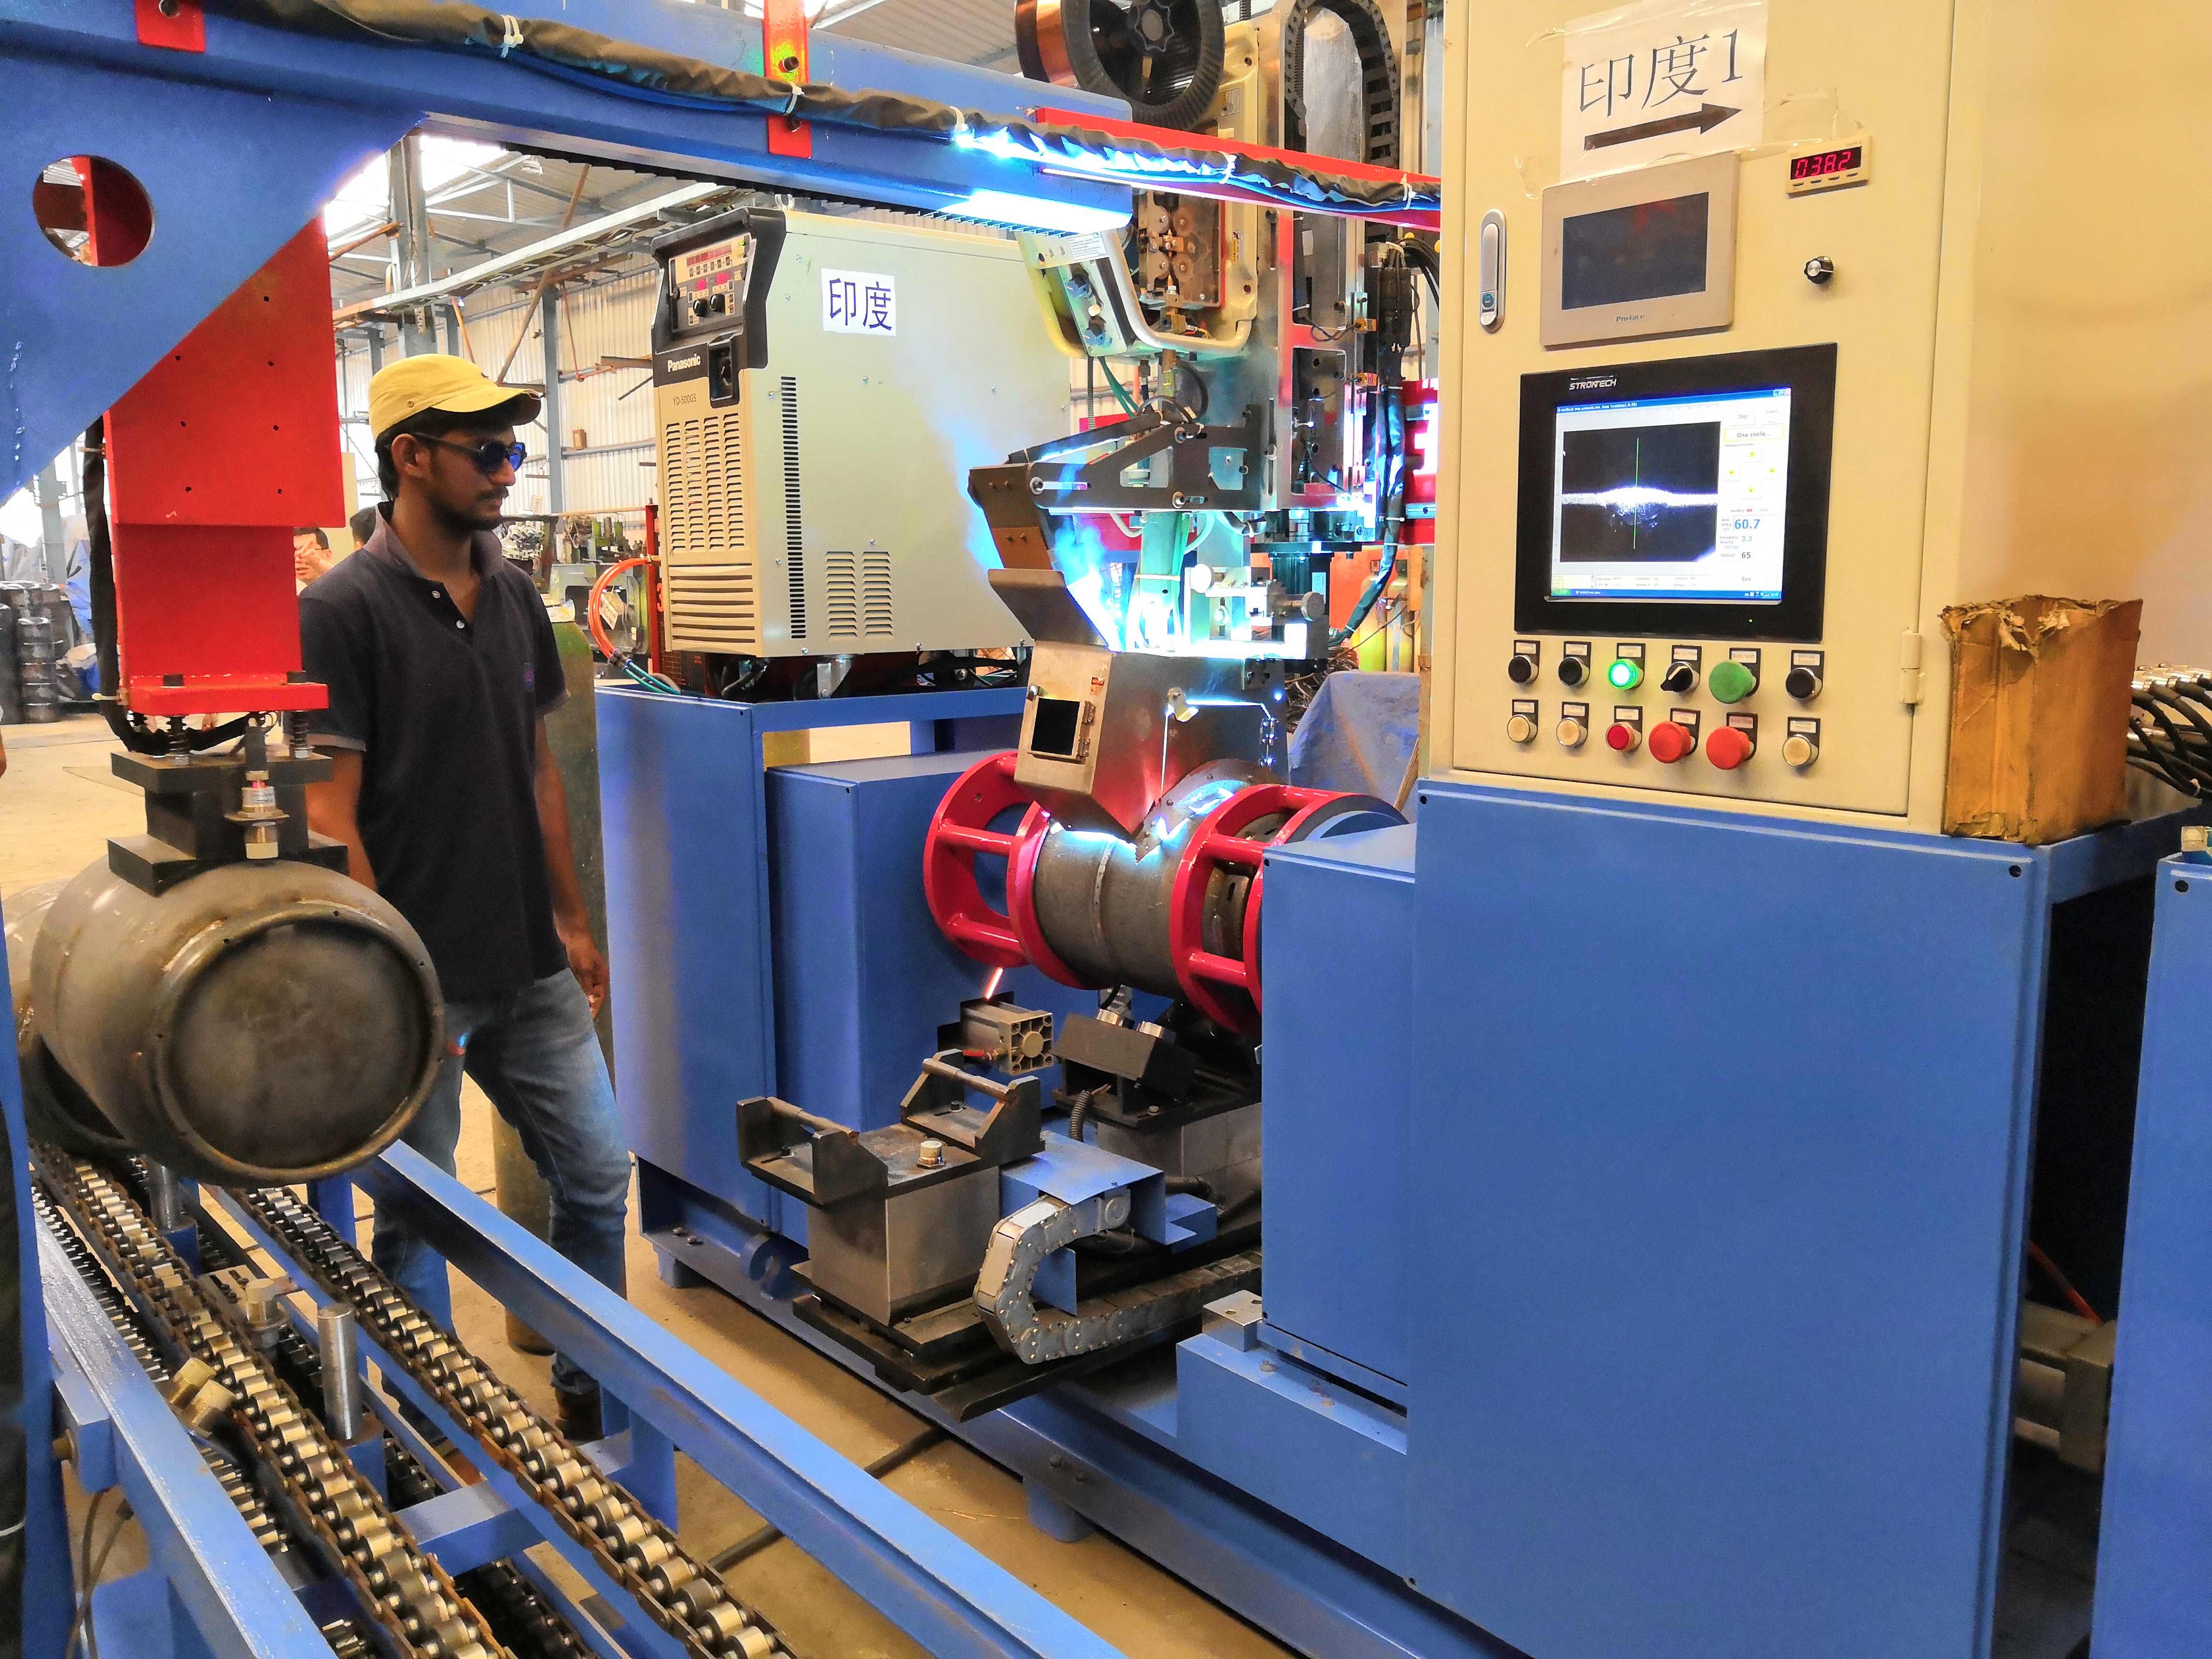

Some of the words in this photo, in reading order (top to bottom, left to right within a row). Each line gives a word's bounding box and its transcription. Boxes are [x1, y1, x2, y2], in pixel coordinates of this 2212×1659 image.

[829, 277, 892, 331] 印度
[667, 353, 701, 373] Panasonic
[673, 394, 697, 405] YD-500GS
[1734, 519, 1760, 529] 60.7
